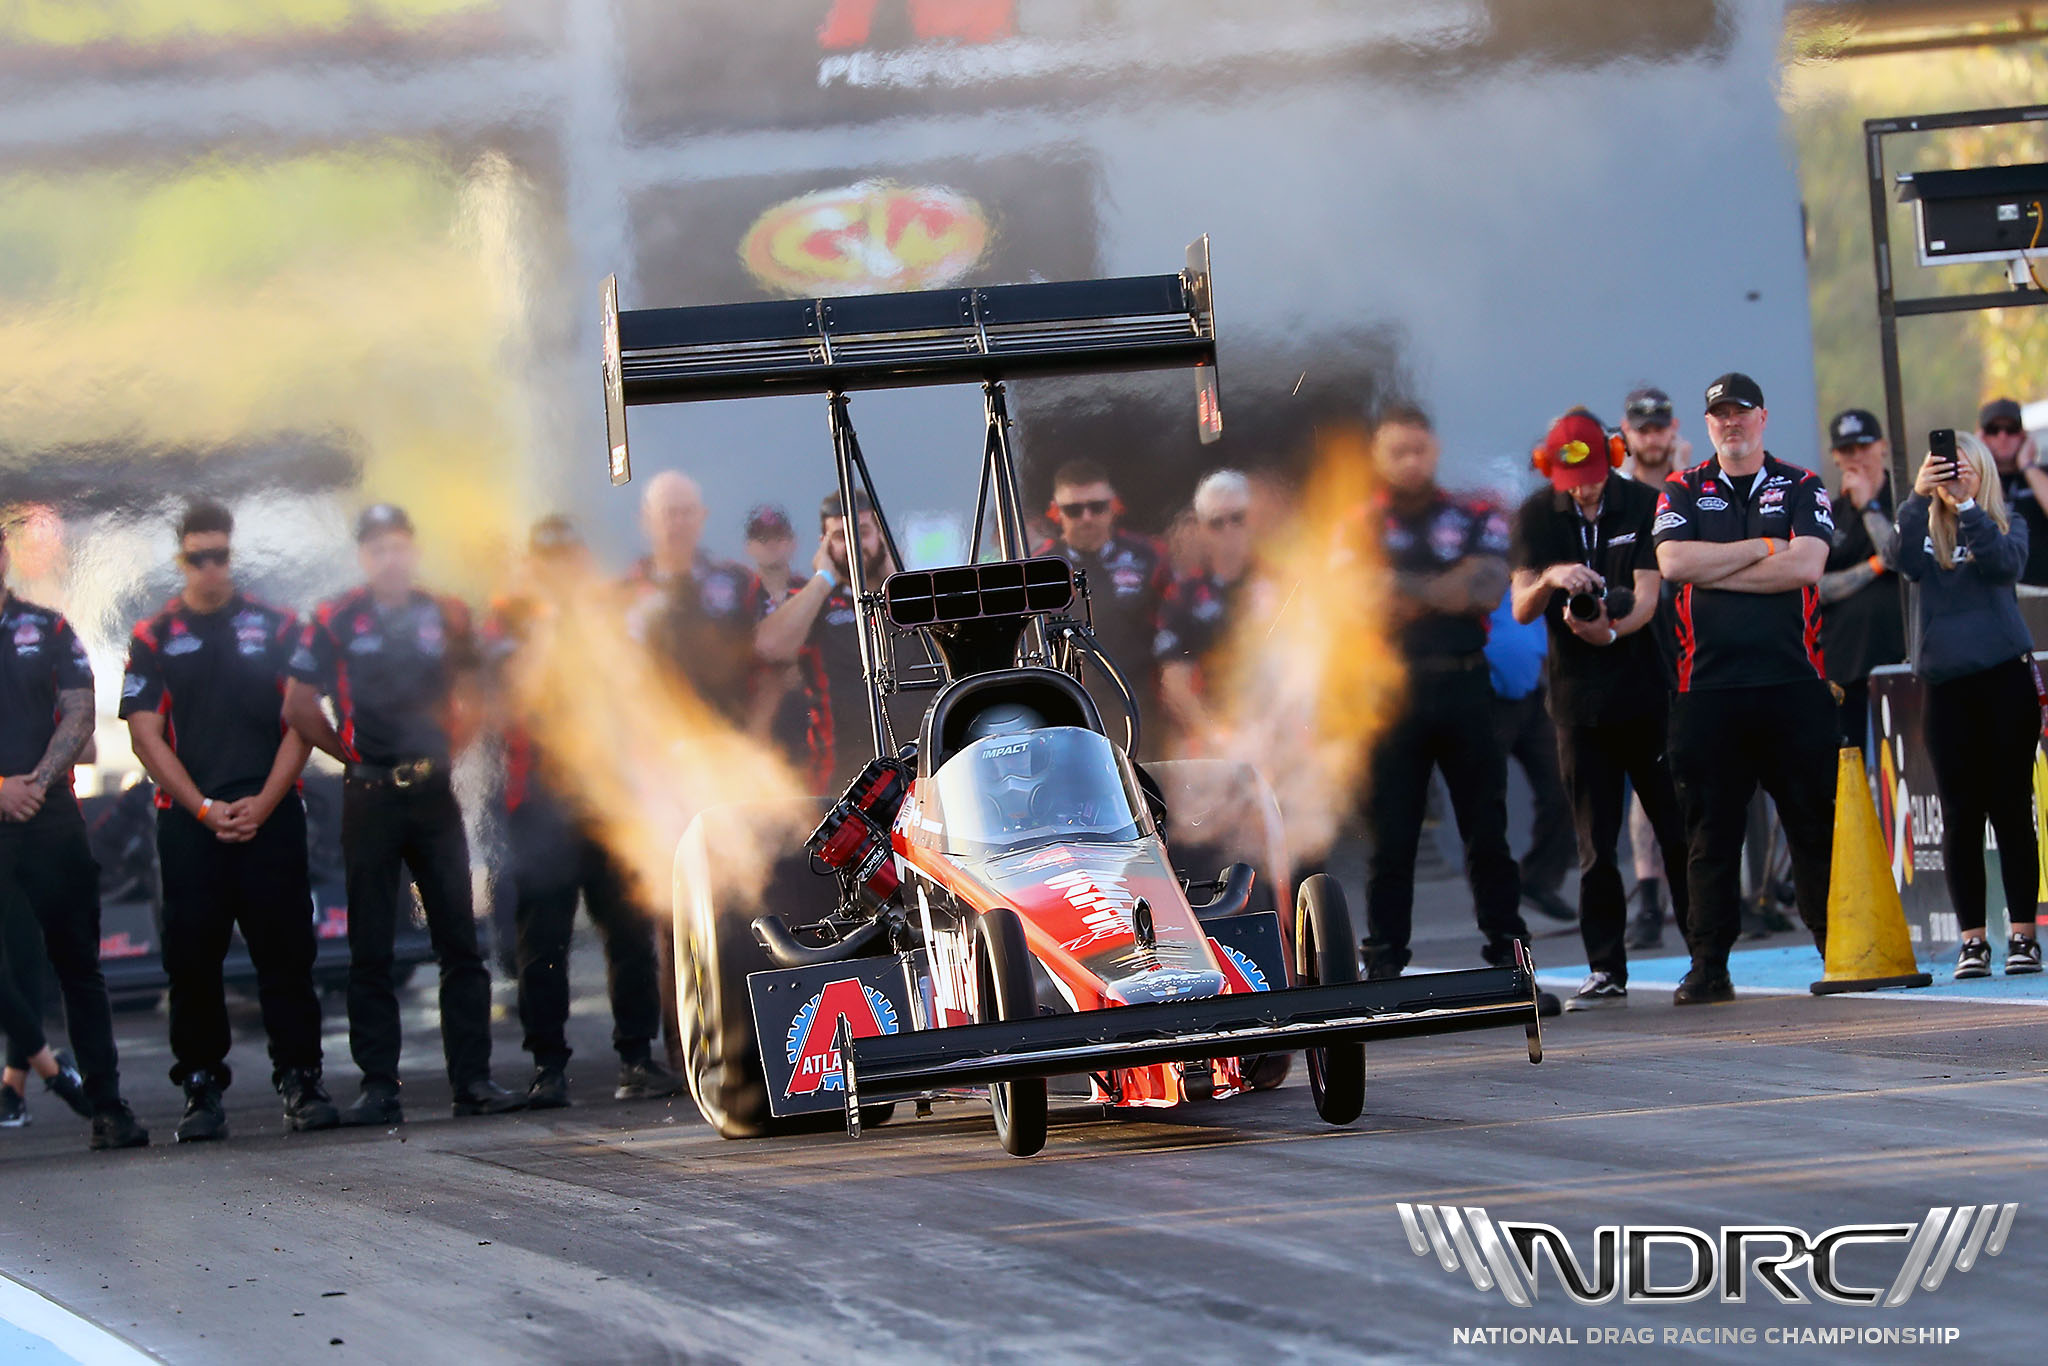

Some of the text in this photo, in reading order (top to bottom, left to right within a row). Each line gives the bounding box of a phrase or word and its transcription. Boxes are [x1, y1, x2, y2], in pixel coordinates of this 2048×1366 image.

[982, 742, 1029, 760] IMPACT
[856, 846, 885, 882] RAPISA
[801, 1051, 843, 1076] ATLA
